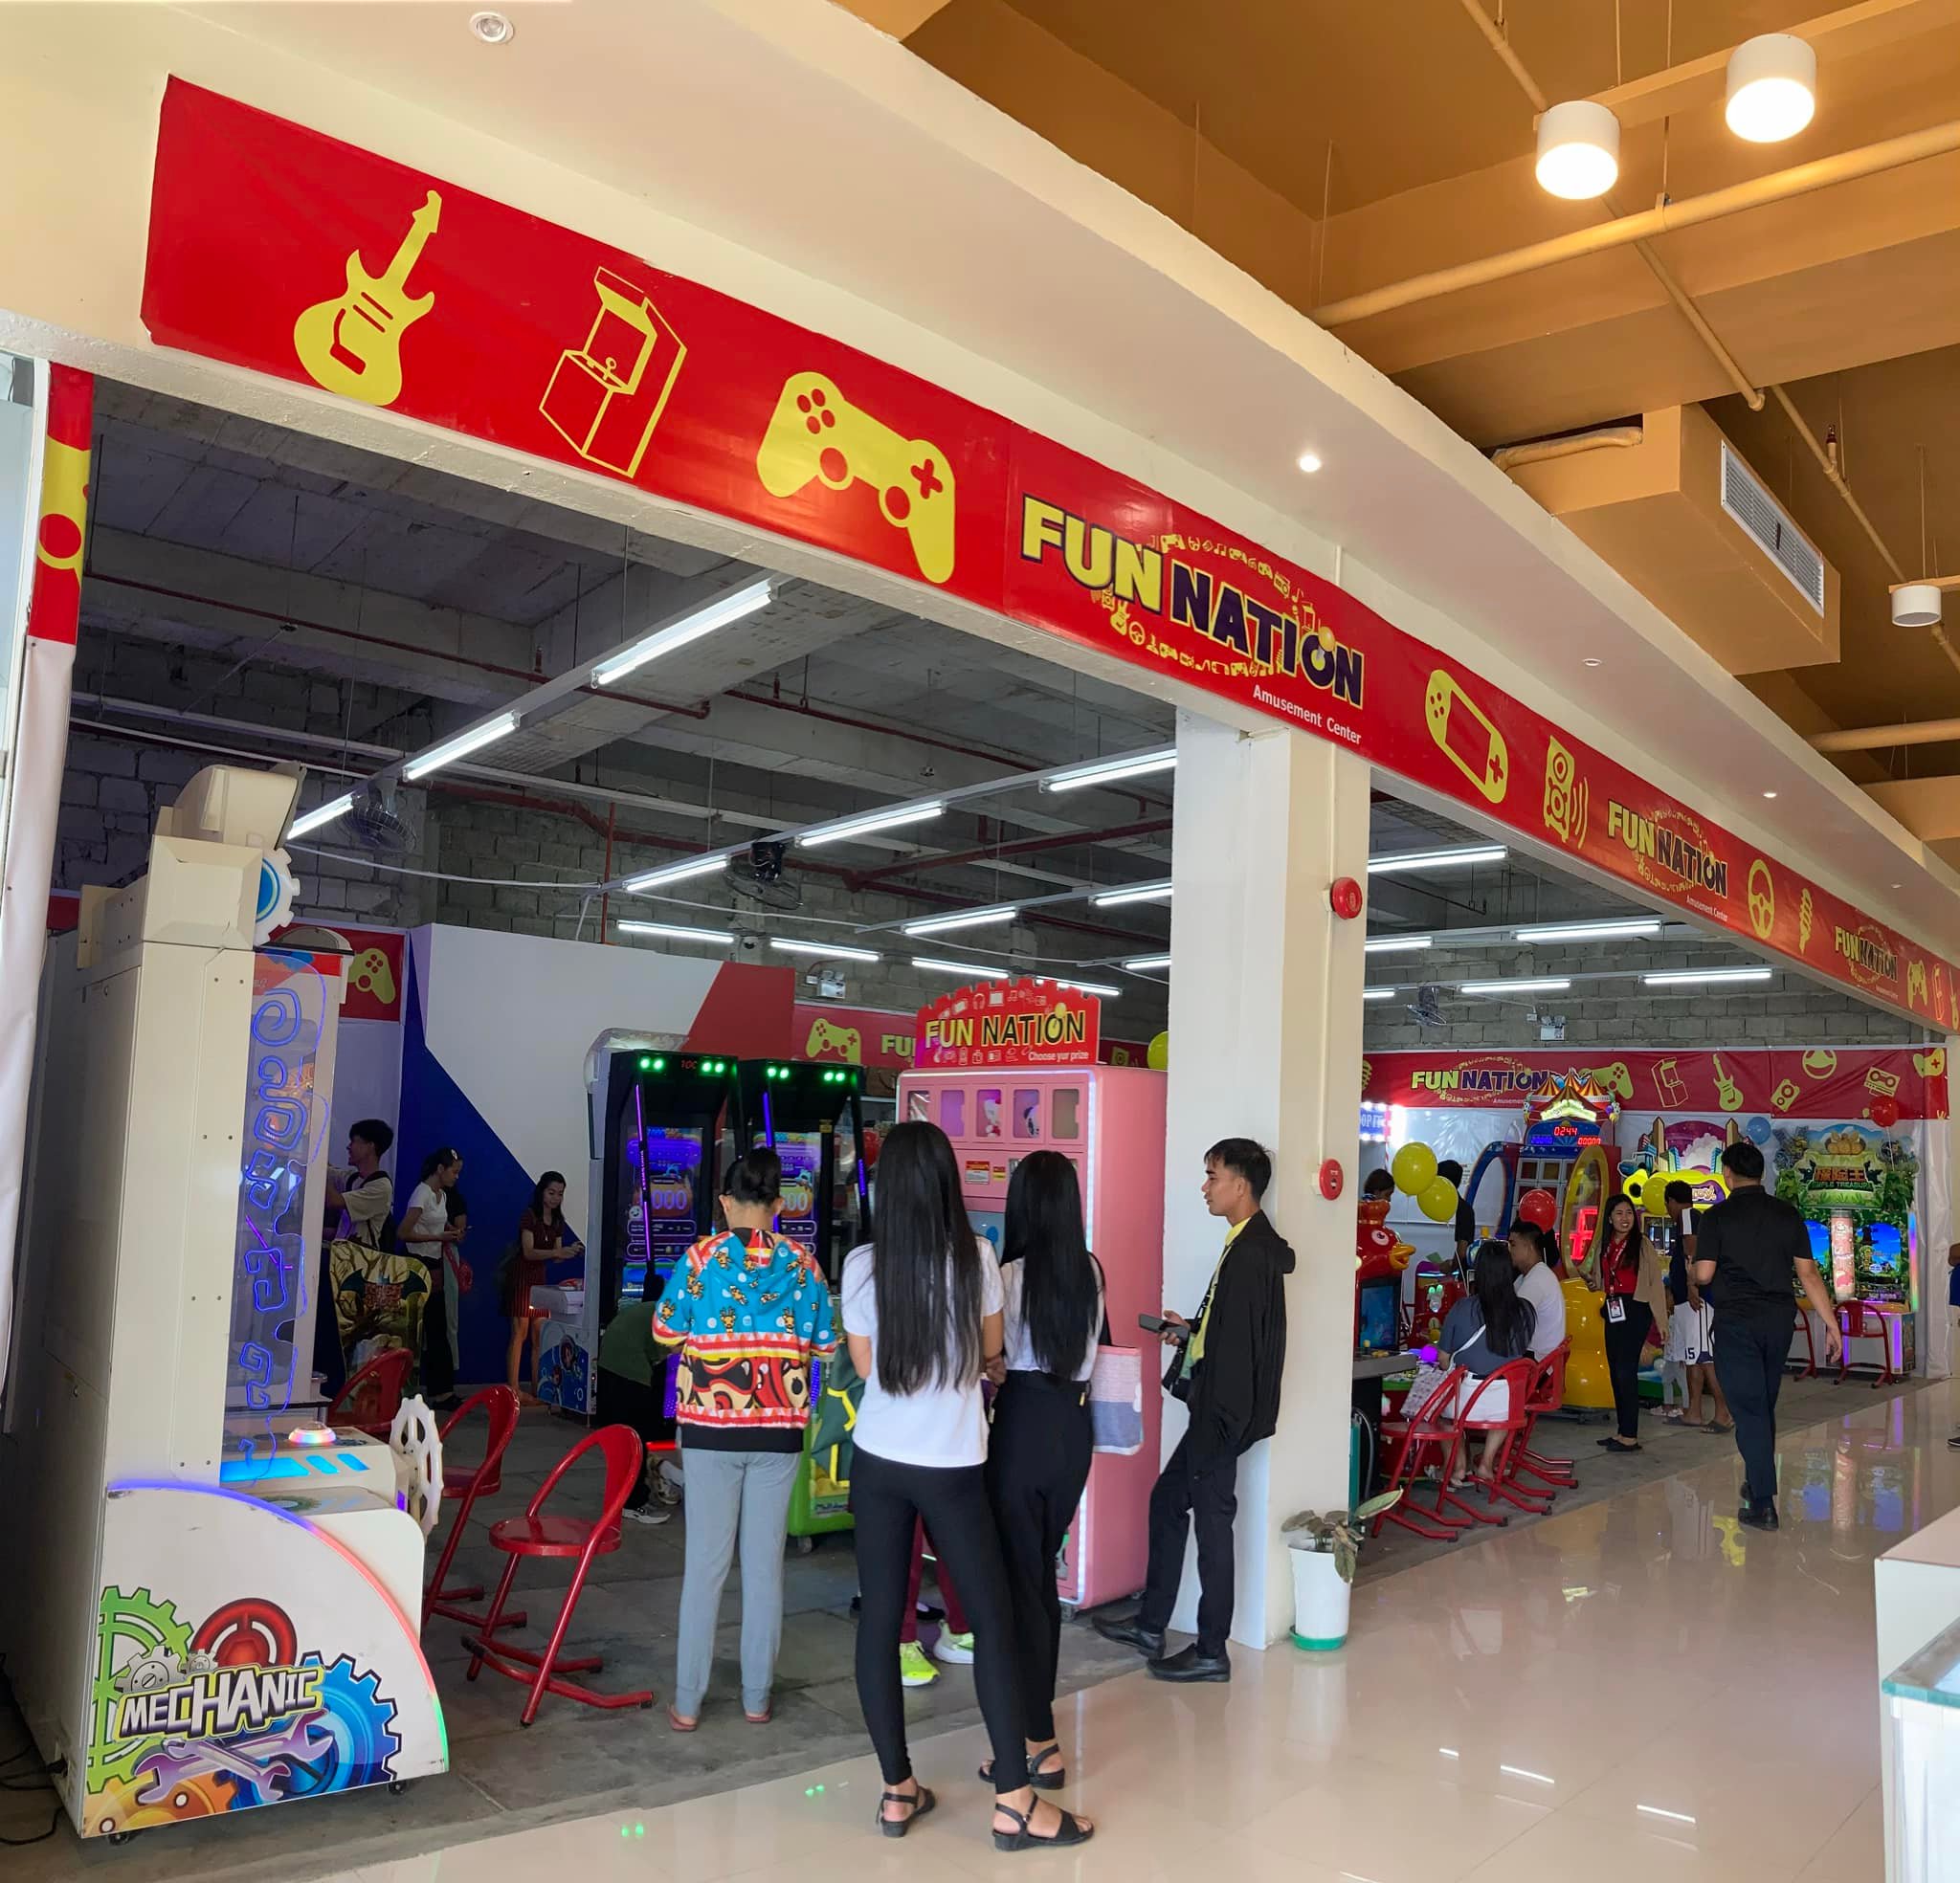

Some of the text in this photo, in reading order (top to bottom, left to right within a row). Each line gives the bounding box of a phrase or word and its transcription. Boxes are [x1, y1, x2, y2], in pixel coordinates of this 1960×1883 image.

[1020, 493, 1365, 711] FUN NATION
[1253, 684, 1362, 745] Amusement Center
[1608, 800, 1727, 899] FUN NATION
[1835, 925, 1898, 984] FUN NATION
[925, 1010, 1085, 1049] FUN NATION
[1412, 1069, 1549, 1092] FUN NATION
[1554, 1126, 1577, 1136] 0244
[119, 1669, 320, 1739] MECHANIC
